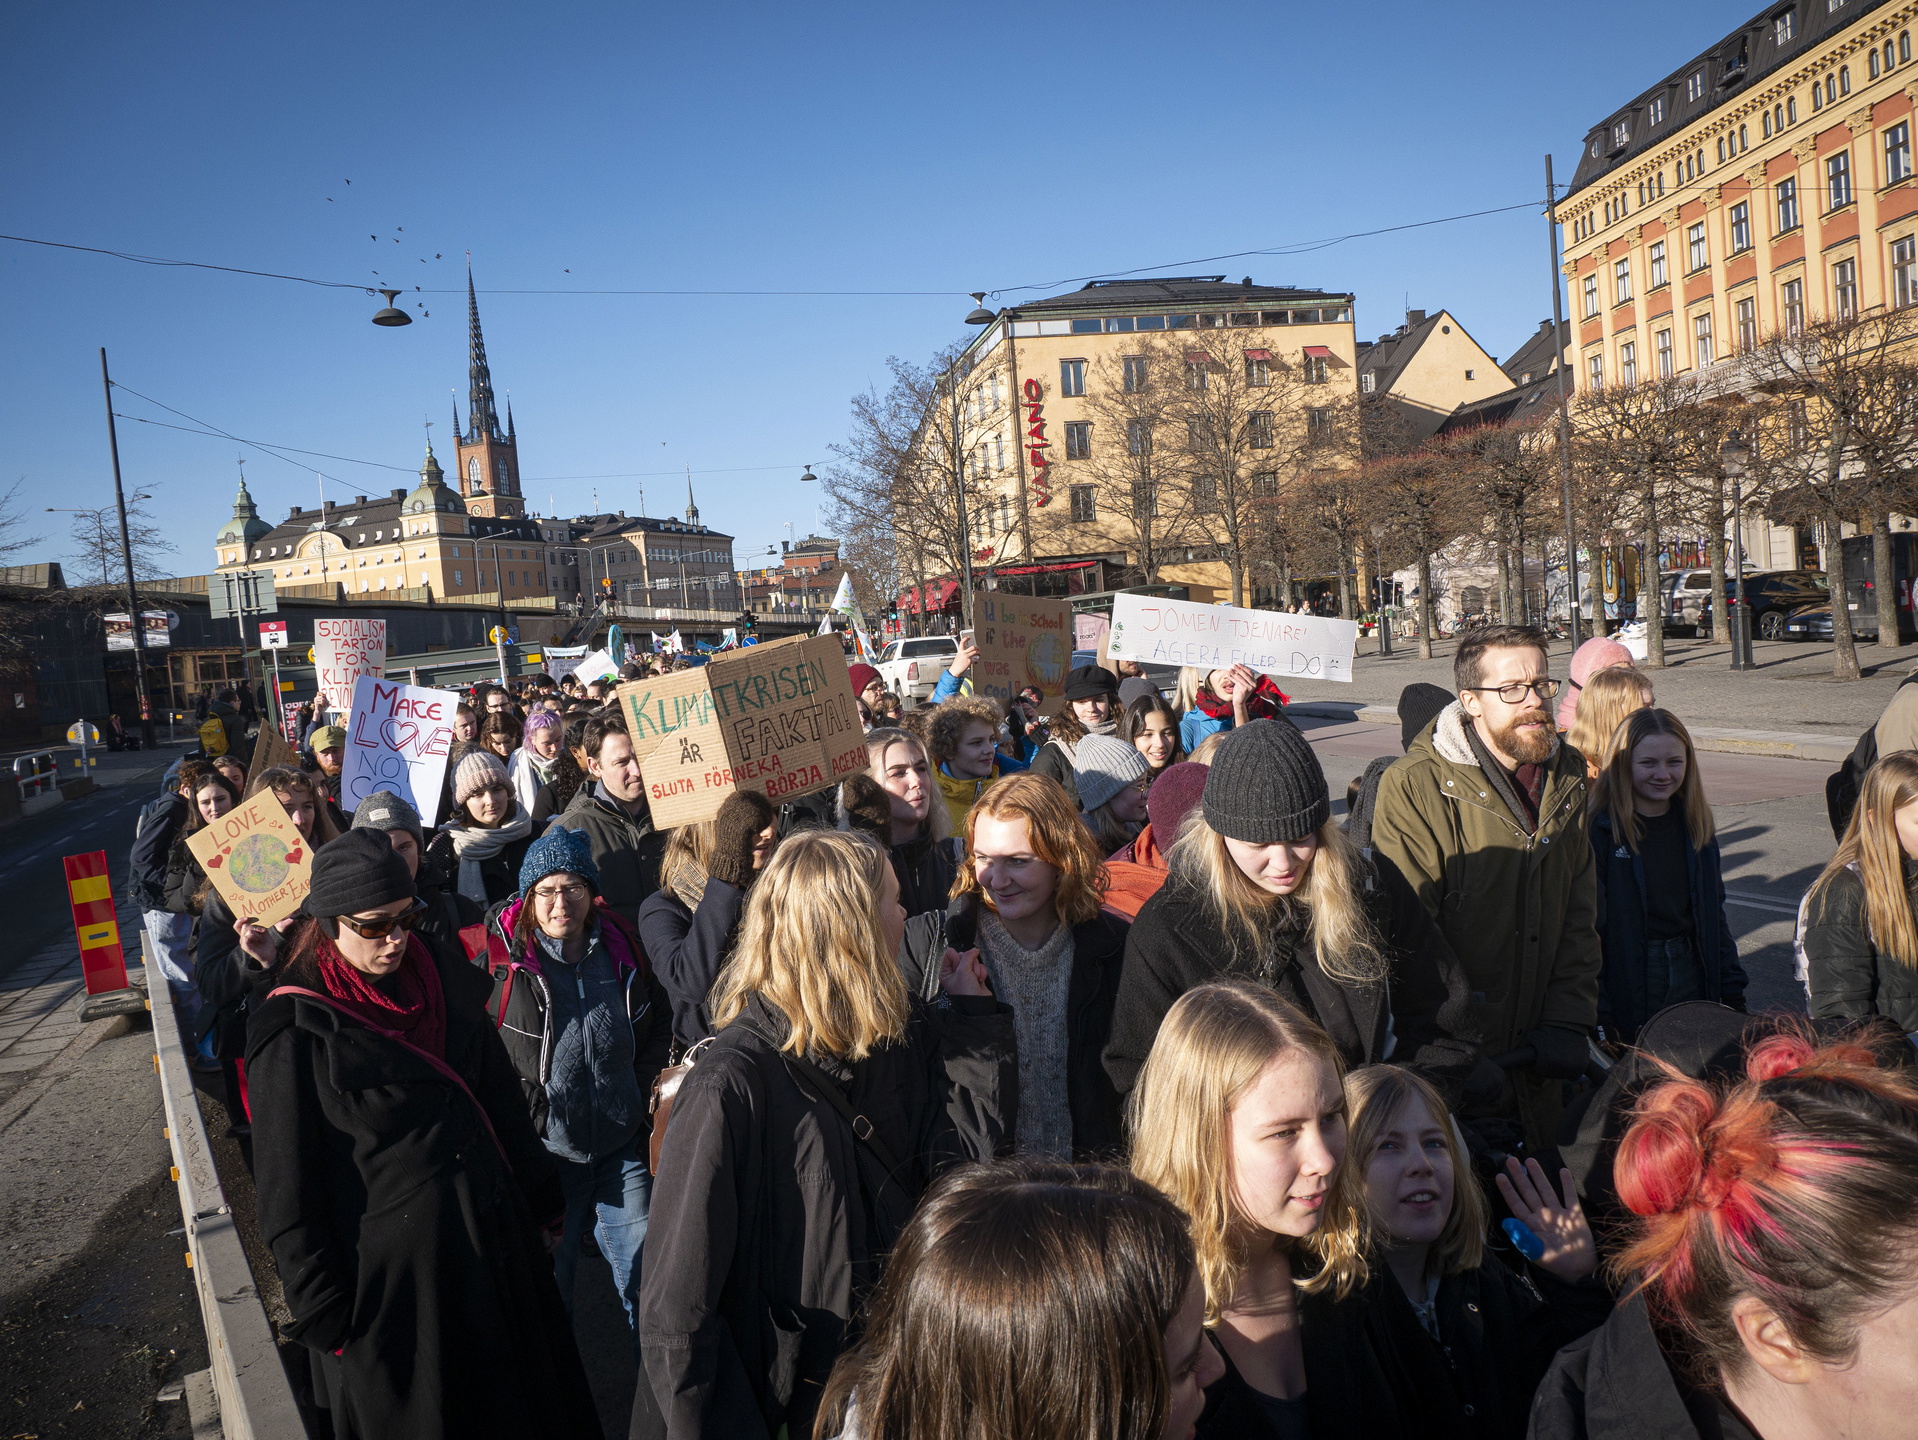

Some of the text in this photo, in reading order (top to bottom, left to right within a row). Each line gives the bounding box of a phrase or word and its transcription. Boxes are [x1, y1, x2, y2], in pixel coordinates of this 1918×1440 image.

[1020, 378, 1050, 507] VAPIANO
[1001, 602, 1016, 623] be
[1141, 608, 1221, 632] JOMEN
[985, 627, 1026, 649] if the
[335, 651, 371, 666] FÖR
[984, 661, 1010, 676] was
[1153, 639, 1322, 675] AGERA ELLER DÖ
[371, 683, 442, 721] MAKE
[629, 657, 828, 740] KLIMATKRISEN
[984, 681, 1021, 700] cool!
[733, 693, 851, 762] FAKTA!
[358, 750, 425, 784] NOT
[680, 737, 703, 765] ÄR
[651, 754, 783, 800] SLUTA FÖRNEKA
[765, 743, 869, 799] BÖRJA AGERA!
[210, 805, 266, 850] LOVE
[241, 887, 289, 918] MOTHER
